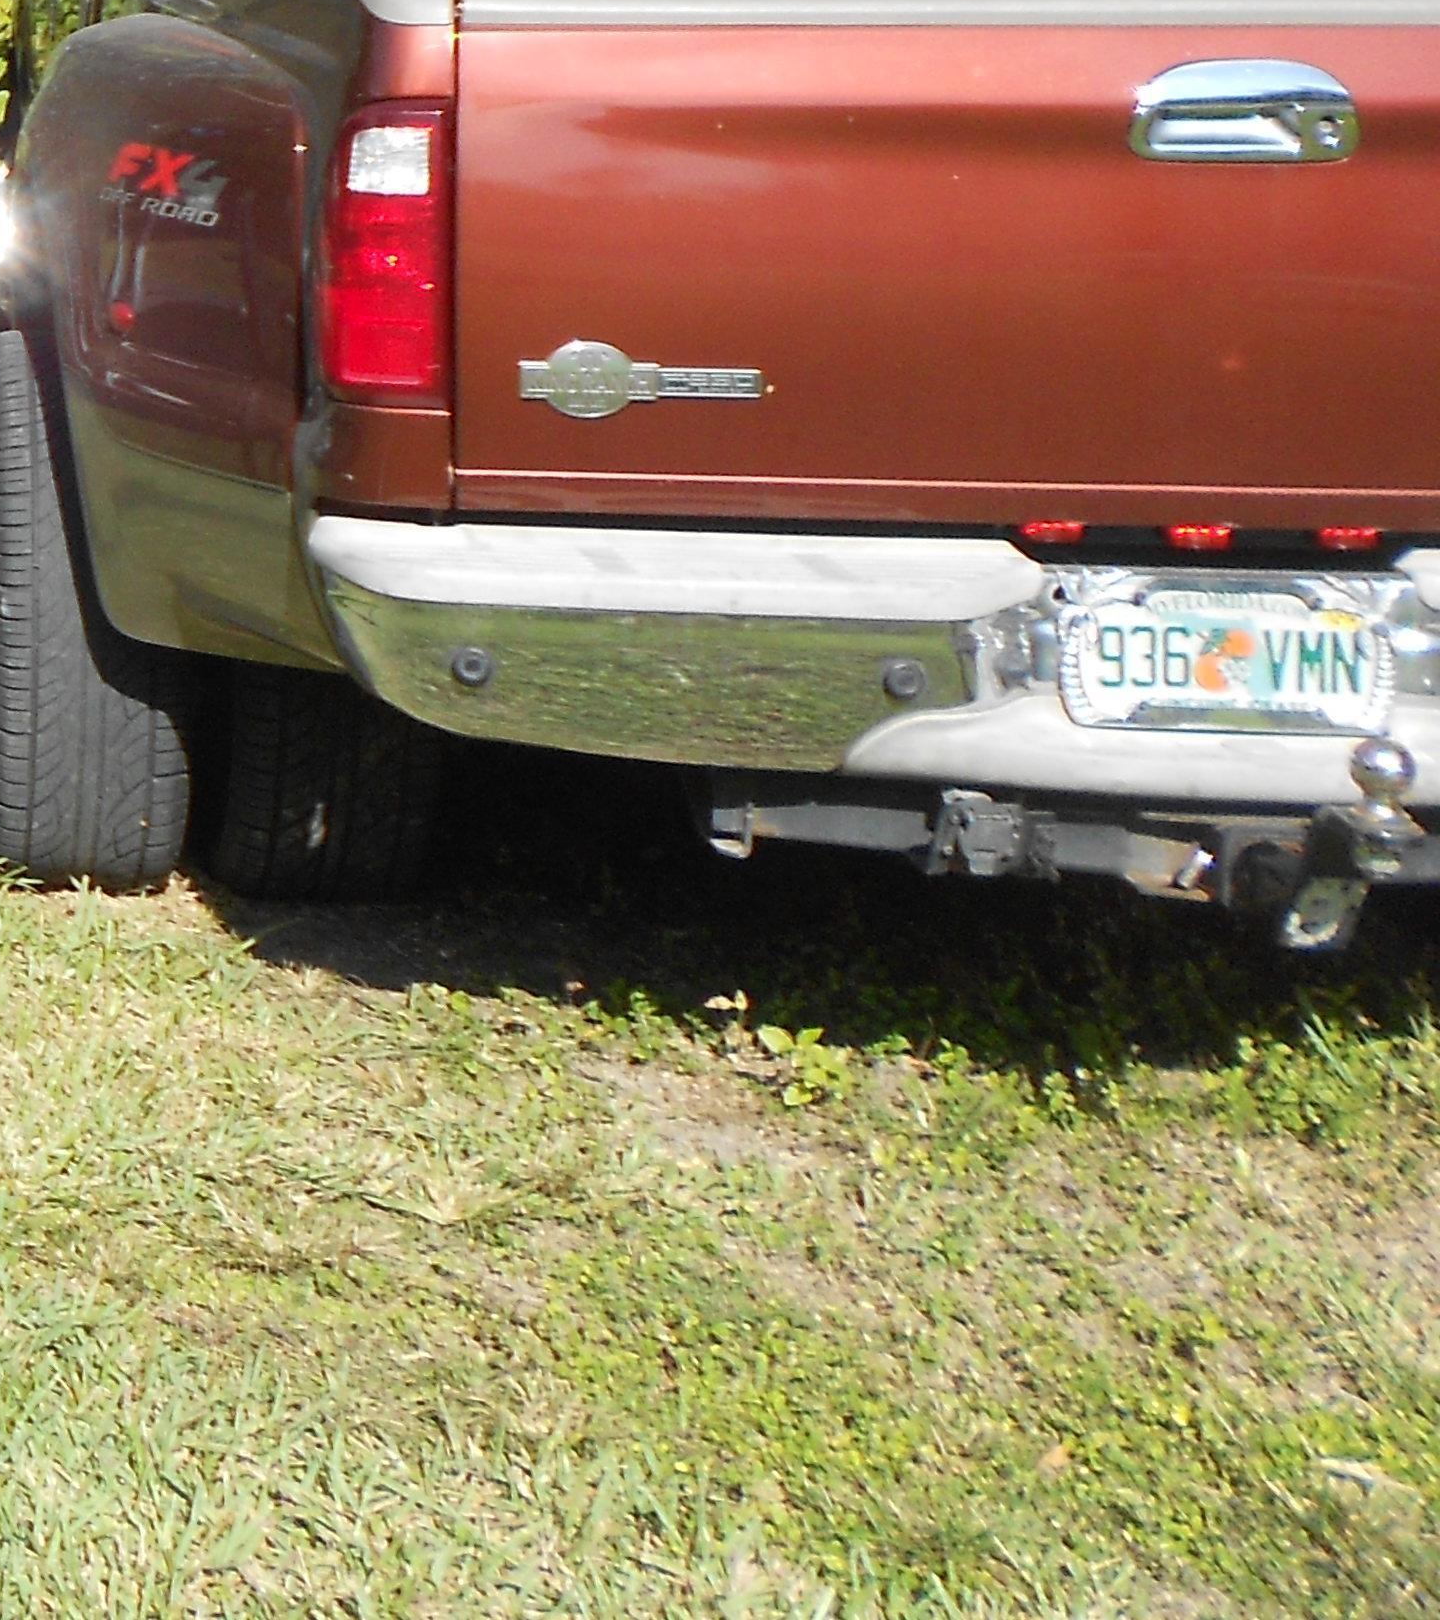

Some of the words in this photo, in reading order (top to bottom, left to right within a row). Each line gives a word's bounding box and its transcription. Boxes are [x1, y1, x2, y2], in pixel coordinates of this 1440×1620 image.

[107, 143, 230, 211] FX4
[140, 197, 219, 227] ROAD
[1100, 625, 1190, 687] 936
[1266, 629, 1364, 694] VMN
